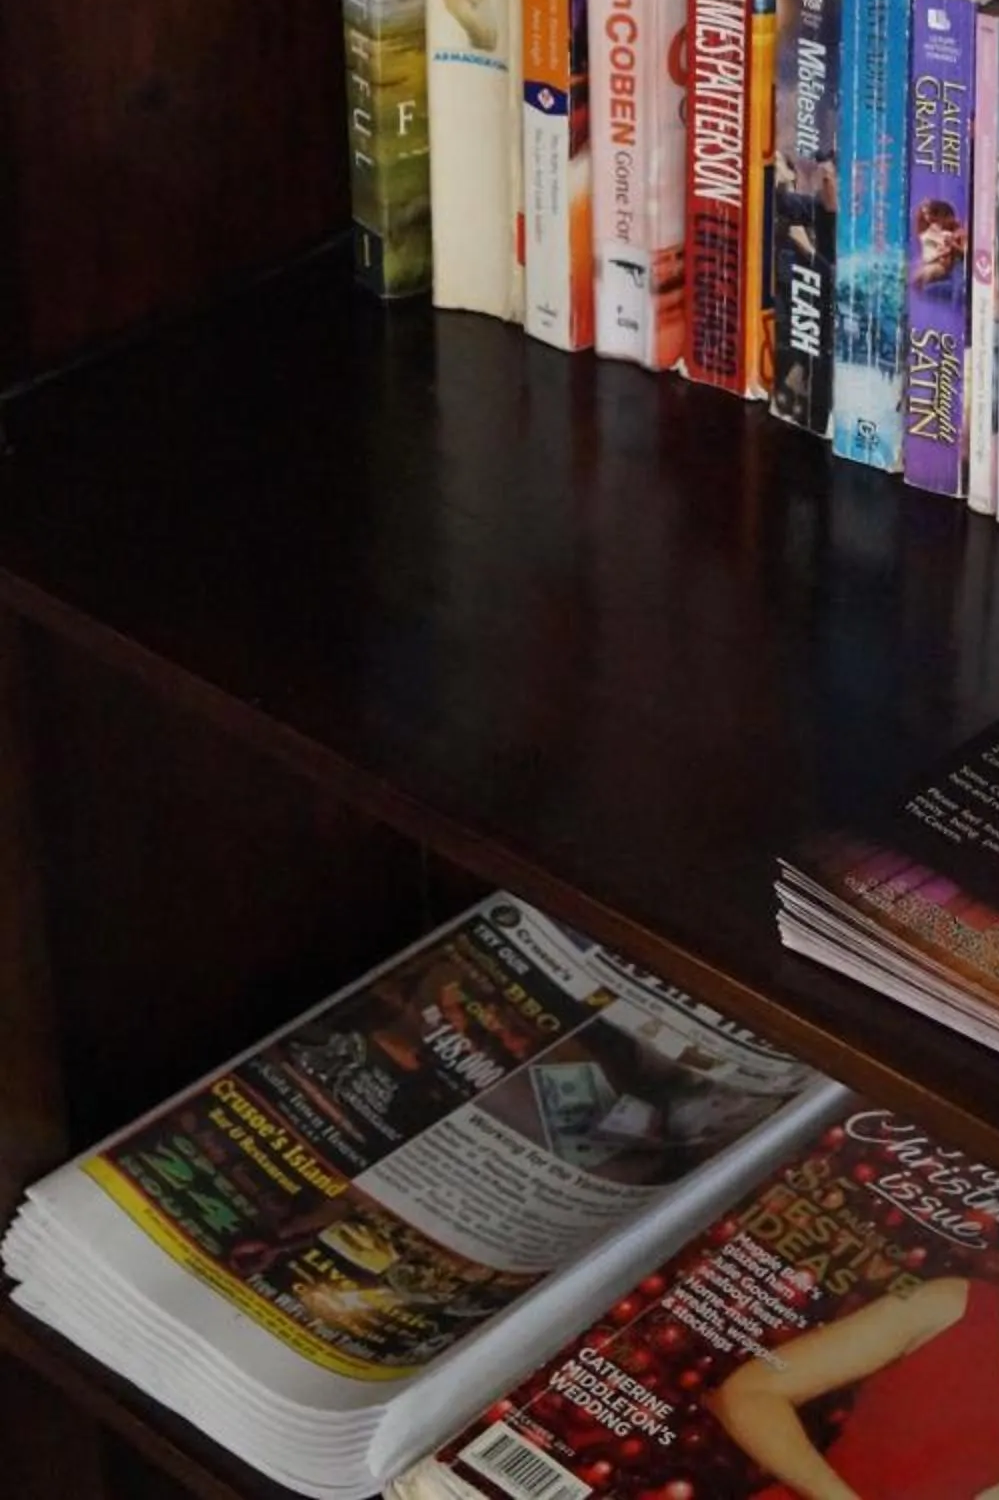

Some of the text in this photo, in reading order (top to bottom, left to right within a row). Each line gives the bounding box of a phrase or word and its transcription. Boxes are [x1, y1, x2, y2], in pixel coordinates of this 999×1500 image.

[605, 13, 638, 147] COBEN
[694, 52, 745, 209] PATTERSON
[914, 75, 942, 173] GRANT
[941, 80, 967, 176] LAURIE
[614, 151, 633, 204] Gone
[615, 208, 635, 245] For
[790, 263, 822, 357] FLASH
[909, 327, 942, 441] SATIN
[469, 923, 505, 950] TRY
[494, 945, 532, 976] OUR
[421, 1023, 506, 1088] 148,000
[210, 1078, 290, 1154] Crusoe's
[283, 1141, 348, 1198] Island
[457, 1113, 535, 1154] Working
[755, 1178, 929, 1301] FESTIVE
[879, 1171, 983, 1238] issue
[710, 1255, 744, 1280] Julie
[718, 1242, 798, 1300] glazed ham
[729, 1201, 865, 1297] IDEAS
[668, 1303, 737, 1353] stockings
[681, 1276, 767, 1338] Home-made
[548, 1371, 631, 1438] WEDDING
[562, 1359, 676, 1446] MIDDLETON'S
[577, 1346, 674, 1420] CATHERINE
